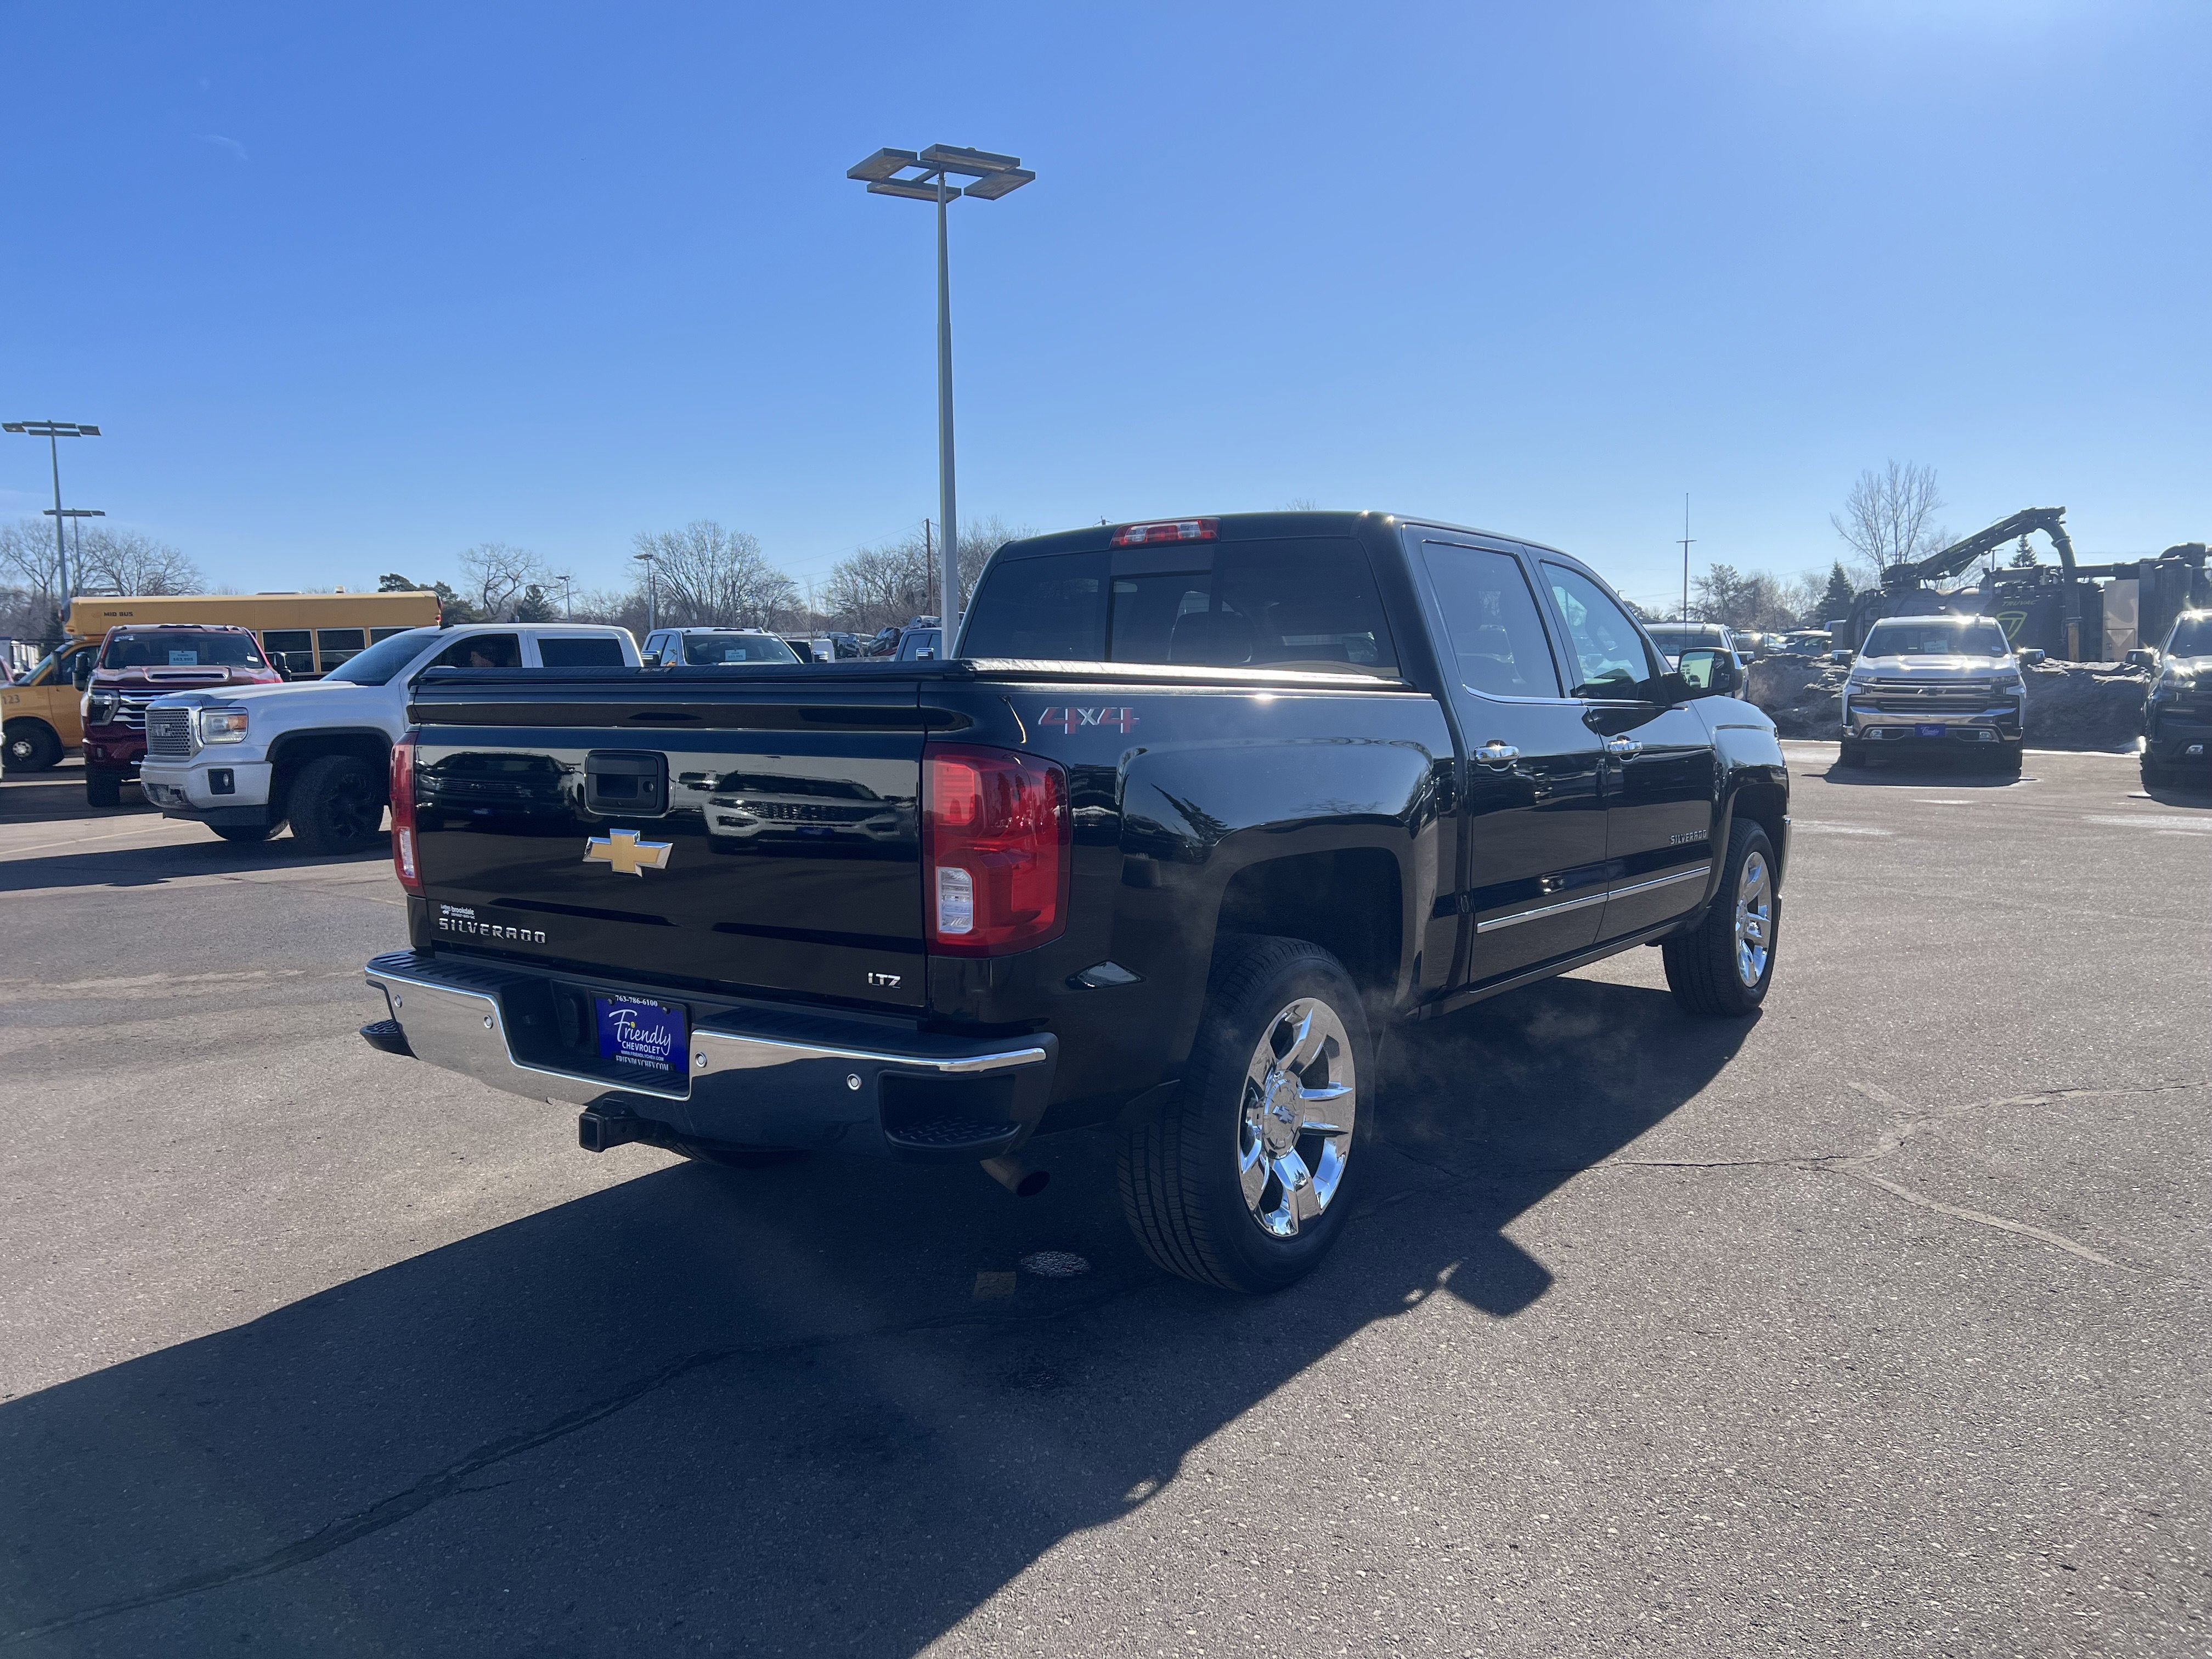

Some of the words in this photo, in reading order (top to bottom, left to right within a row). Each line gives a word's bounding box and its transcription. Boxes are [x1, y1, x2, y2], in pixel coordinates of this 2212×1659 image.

[1670, 830, 1707, 845] SILVERADO
[439, 917, 546, 944] SILVERADO
[868, 972, 901, 989] LTZ
[615, 995, 658, 1007] 763-786-6100
[608, 1009, 671, 1056] Friendly
[622, 1041, 661, 1054] CHEVROLET
